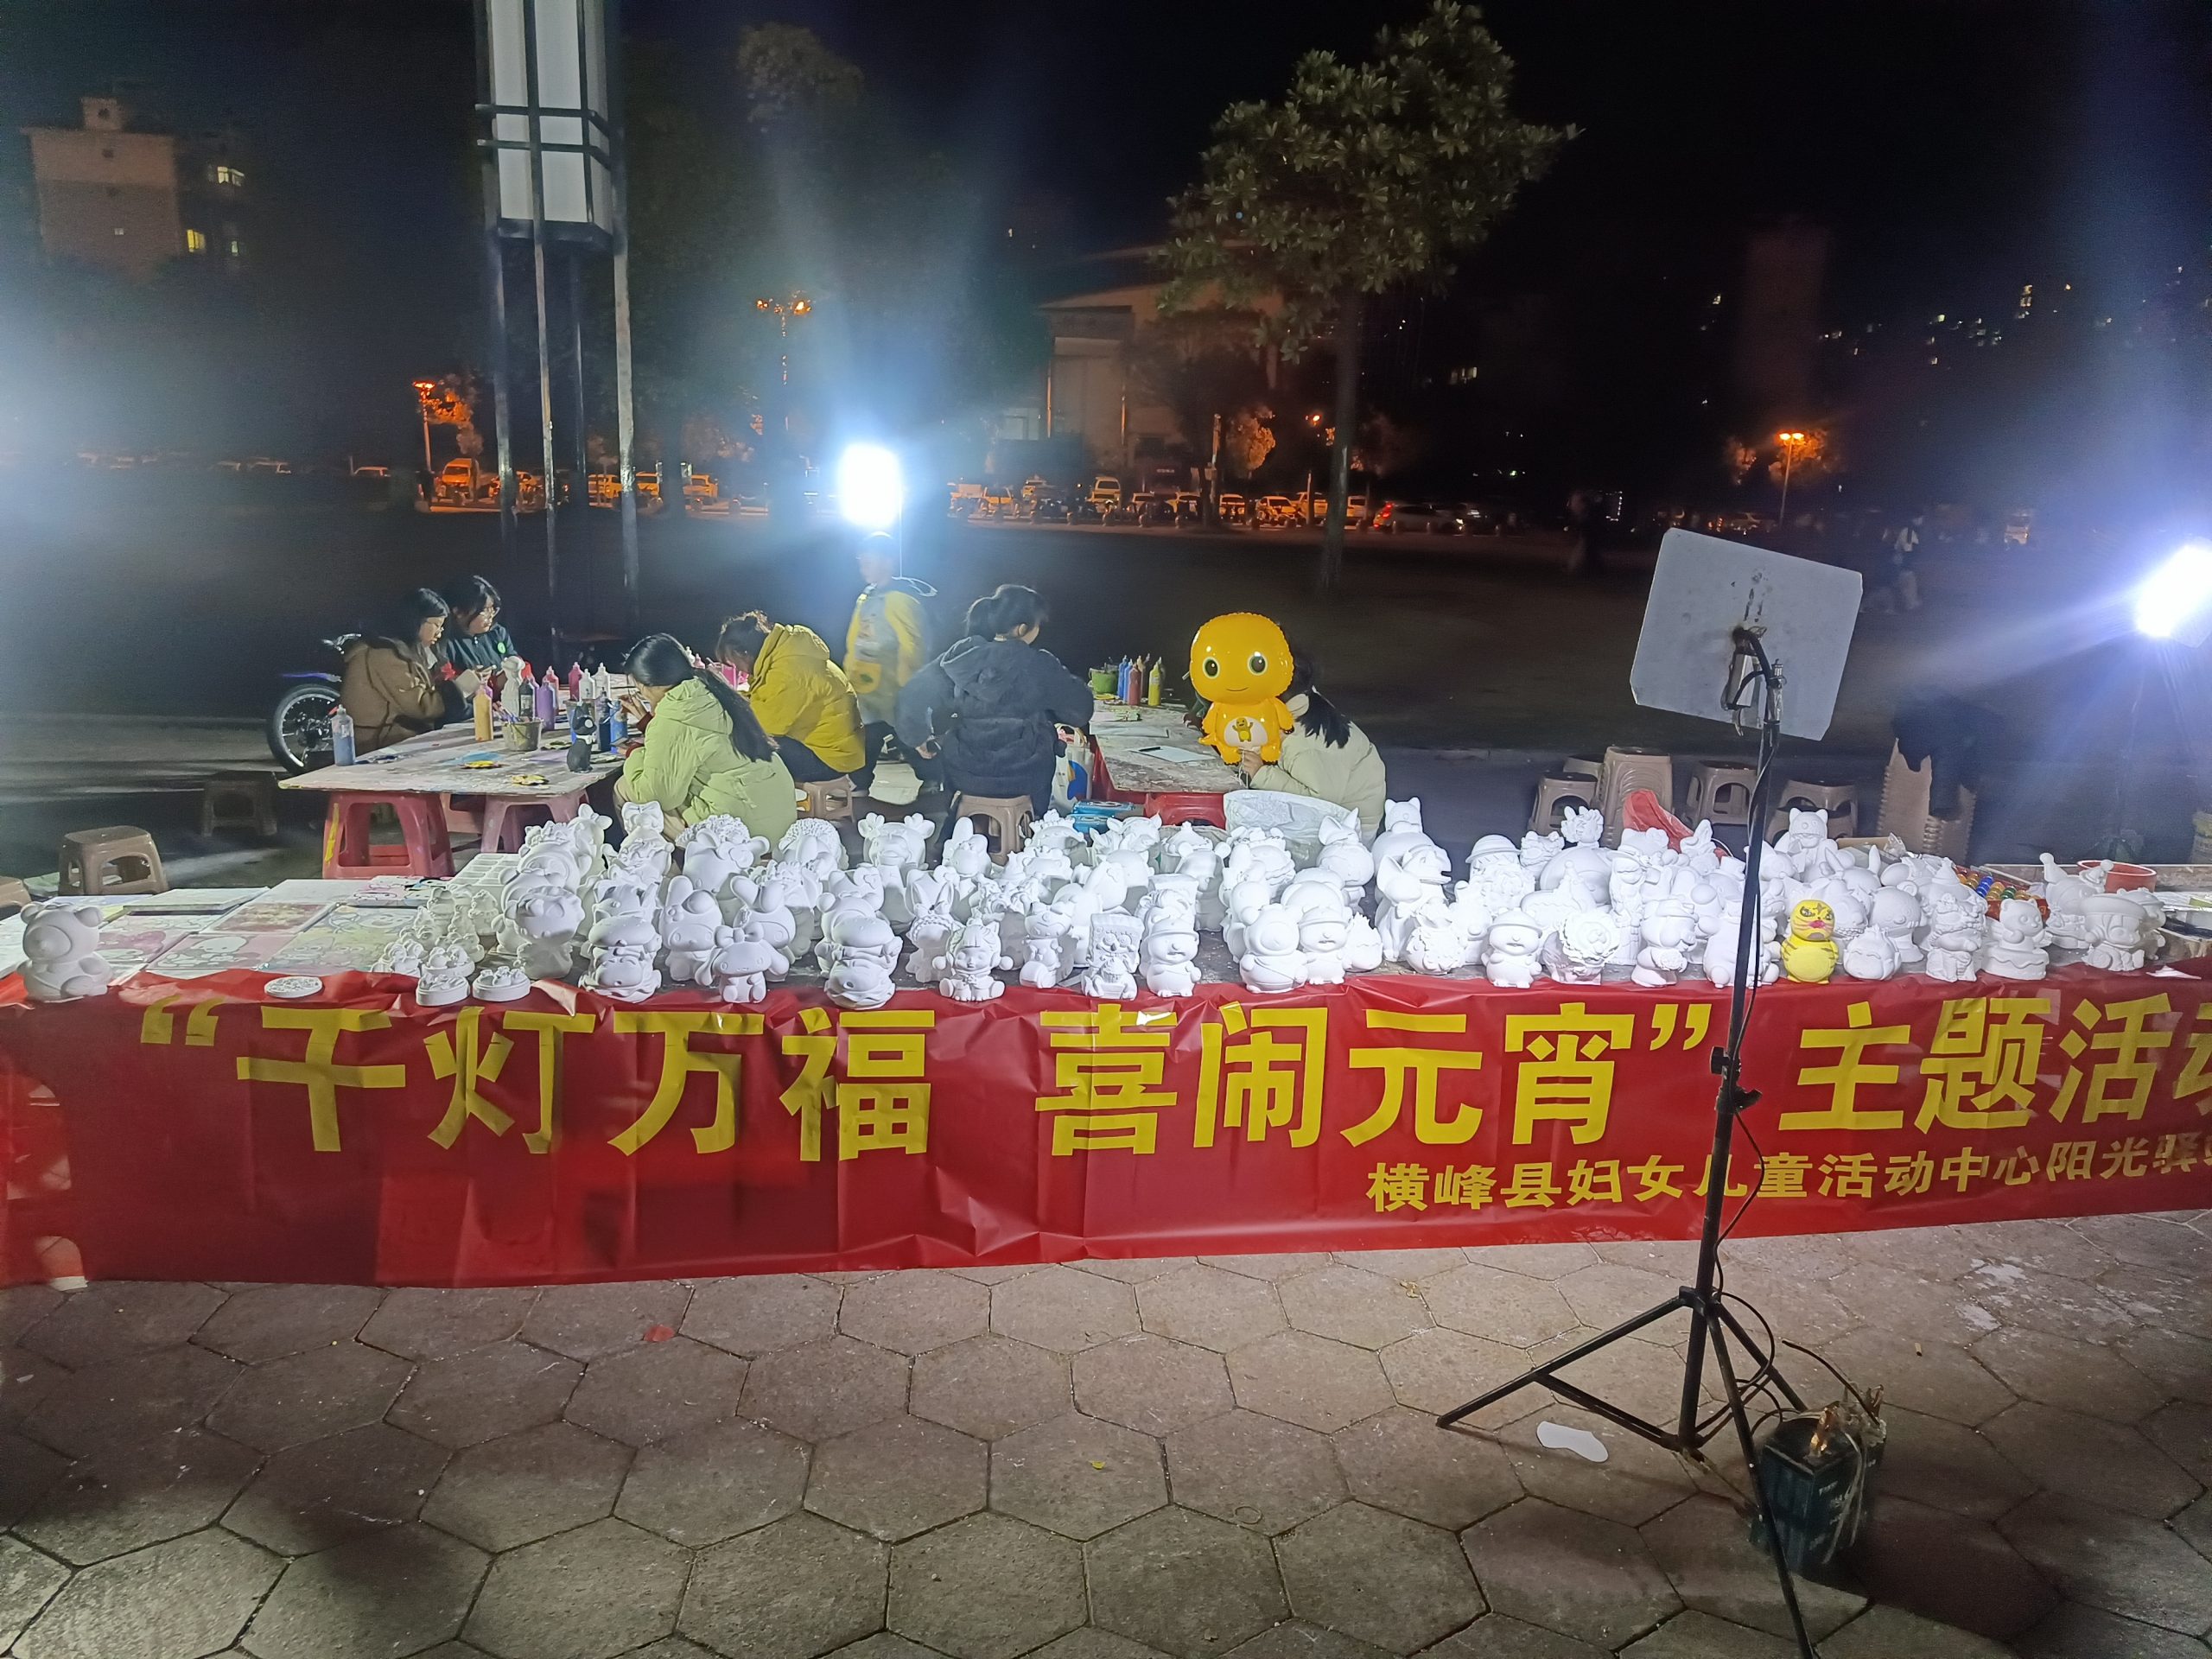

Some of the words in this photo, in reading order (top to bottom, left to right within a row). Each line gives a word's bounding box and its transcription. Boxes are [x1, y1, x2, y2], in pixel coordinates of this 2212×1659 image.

[1777, 993, 2212, 1134] 主题活
[1365, 1133, 2212, 1213] 横峰县妇女儿童活动中心阳光驿
